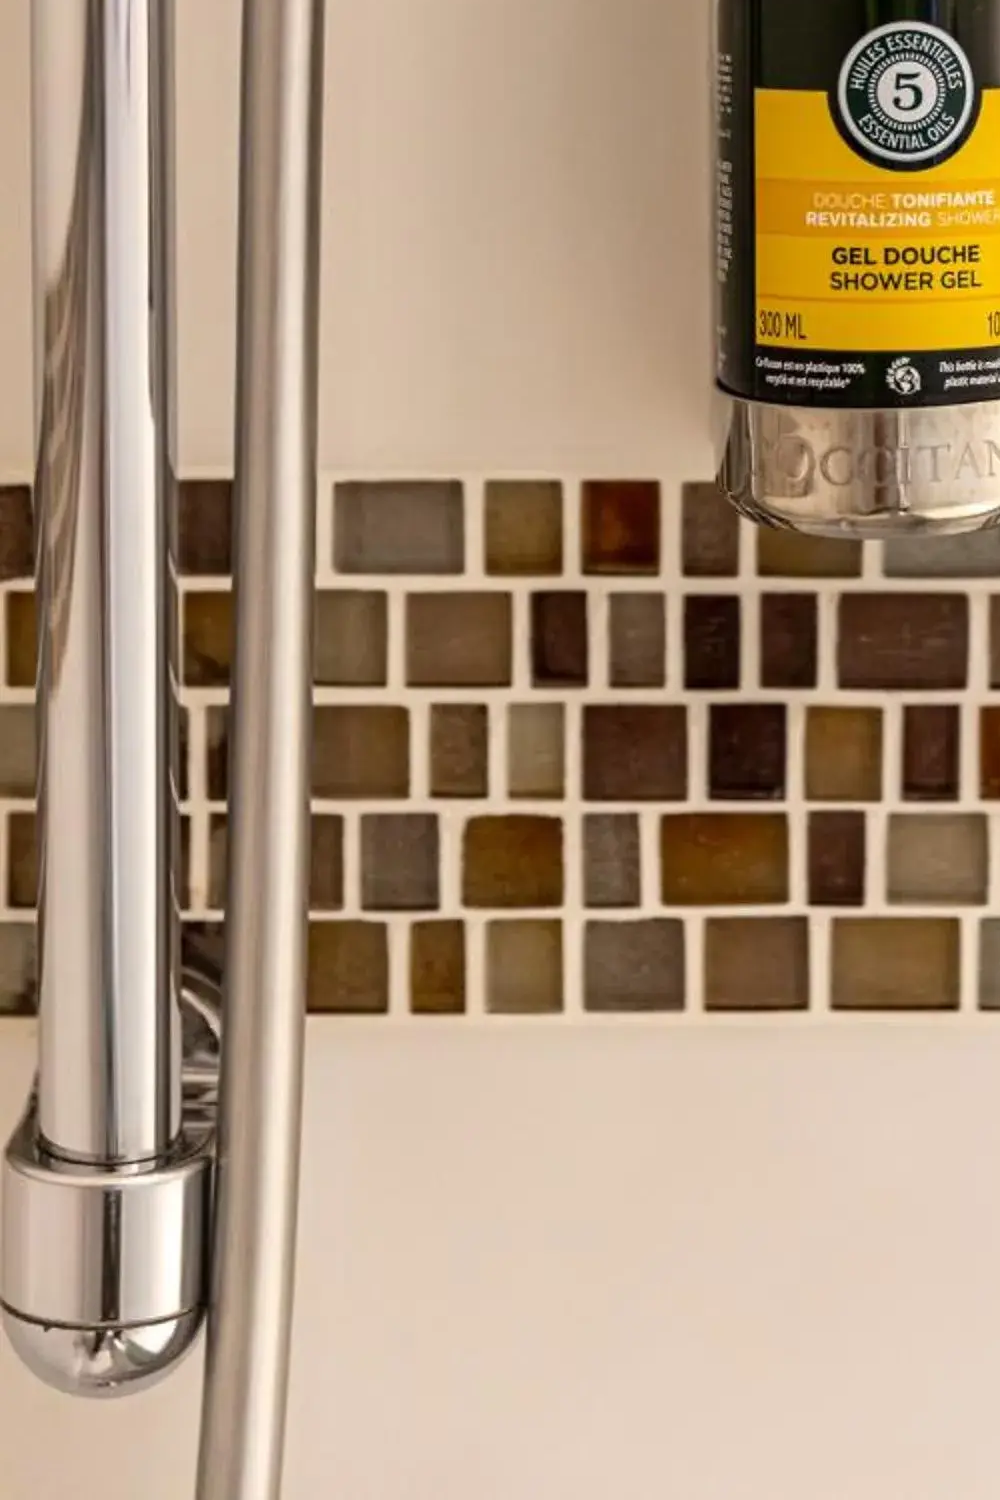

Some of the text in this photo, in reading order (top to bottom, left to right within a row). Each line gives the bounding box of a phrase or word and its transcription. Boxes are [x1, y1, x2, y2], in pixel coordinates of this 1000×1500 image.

[849, 33, 963, 90] HUILES ESSENTIELLES
[892, 72, 923, 111] 5
[859, 112, 955, 149] ESSENTIAL OILS
[813, 189, 995, 209] DOUCHE TONIFIANTE
[805, 211, 932, 228] REVITALIZING
[831, 244, 981, 266] GEL DOUCHE
[829, 269, 982, 291] SHOWER GEL
[760, 309, 807, 340] 300 ML
